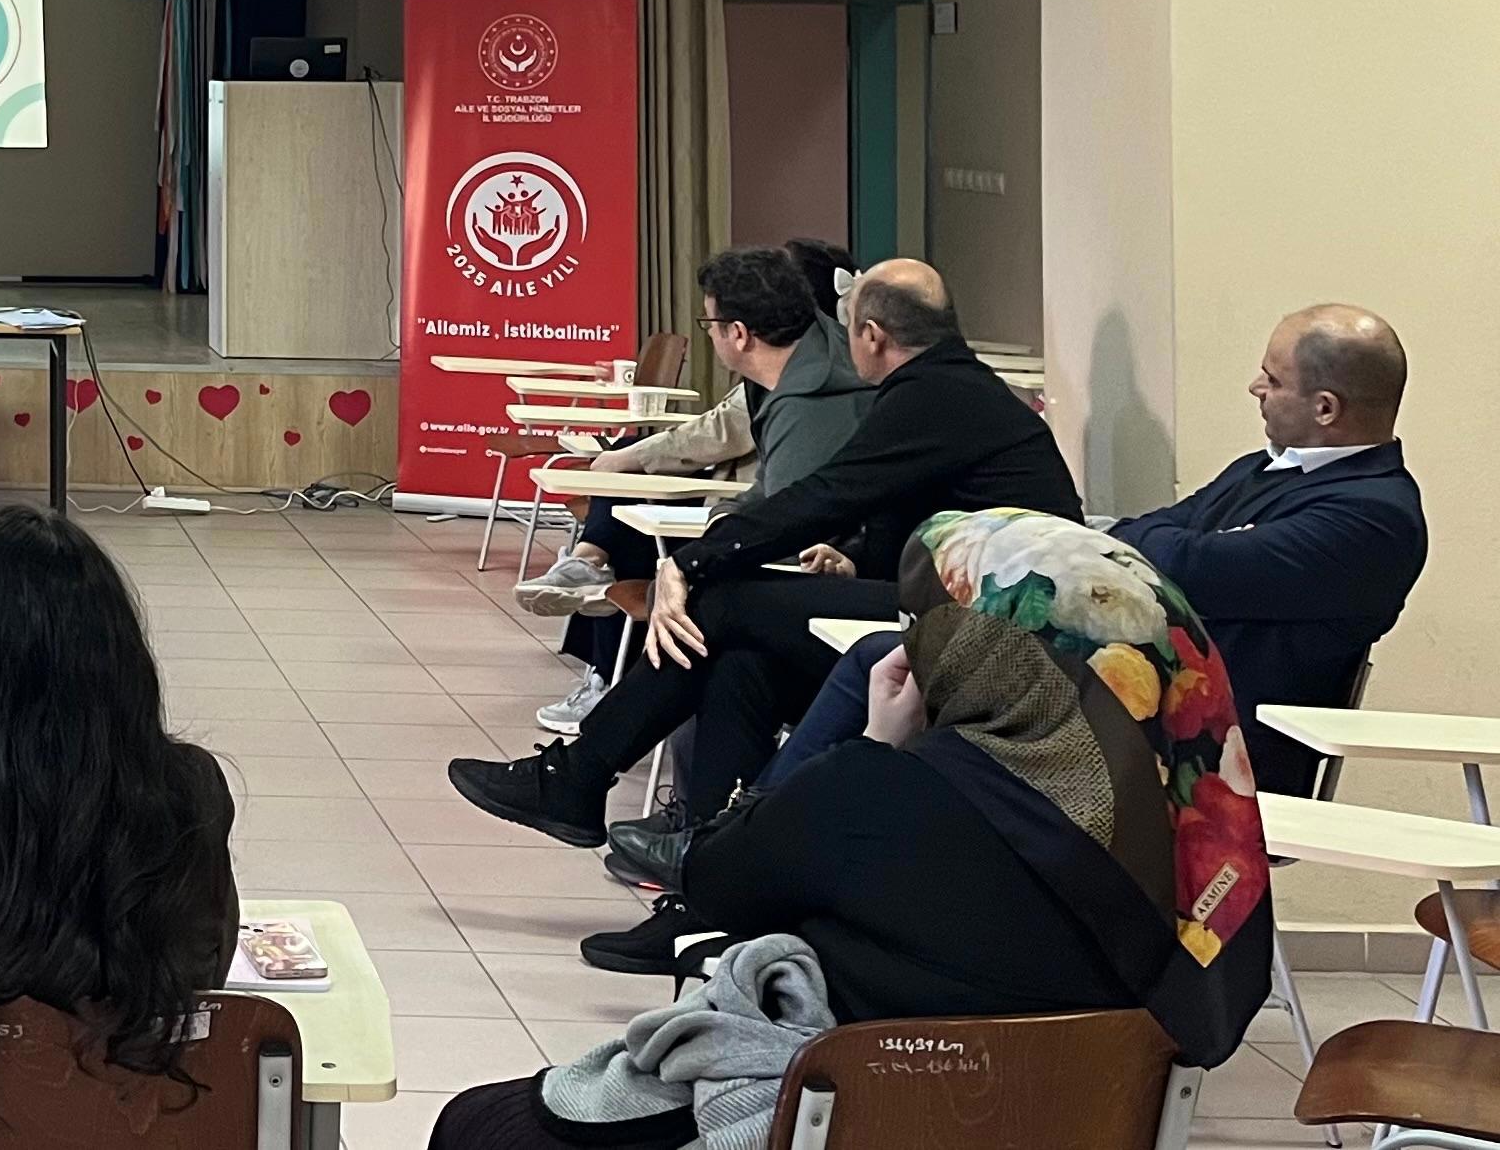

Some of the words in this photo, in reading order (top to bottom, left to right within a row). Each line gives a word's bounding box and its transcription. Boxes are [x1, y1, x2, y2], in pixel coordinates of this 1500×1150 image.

[477, 105, 489, 113] VE
[491, 105, 527, 113] SOSYAL
[505, 95, 549, 104] TRABZON
[446, 243, 487, 287] 2025
[490, 279, 537, 297] AİLE
[541, 255, 580, 288] YILI
[1197, 871, 1235, 914] ARMINE
